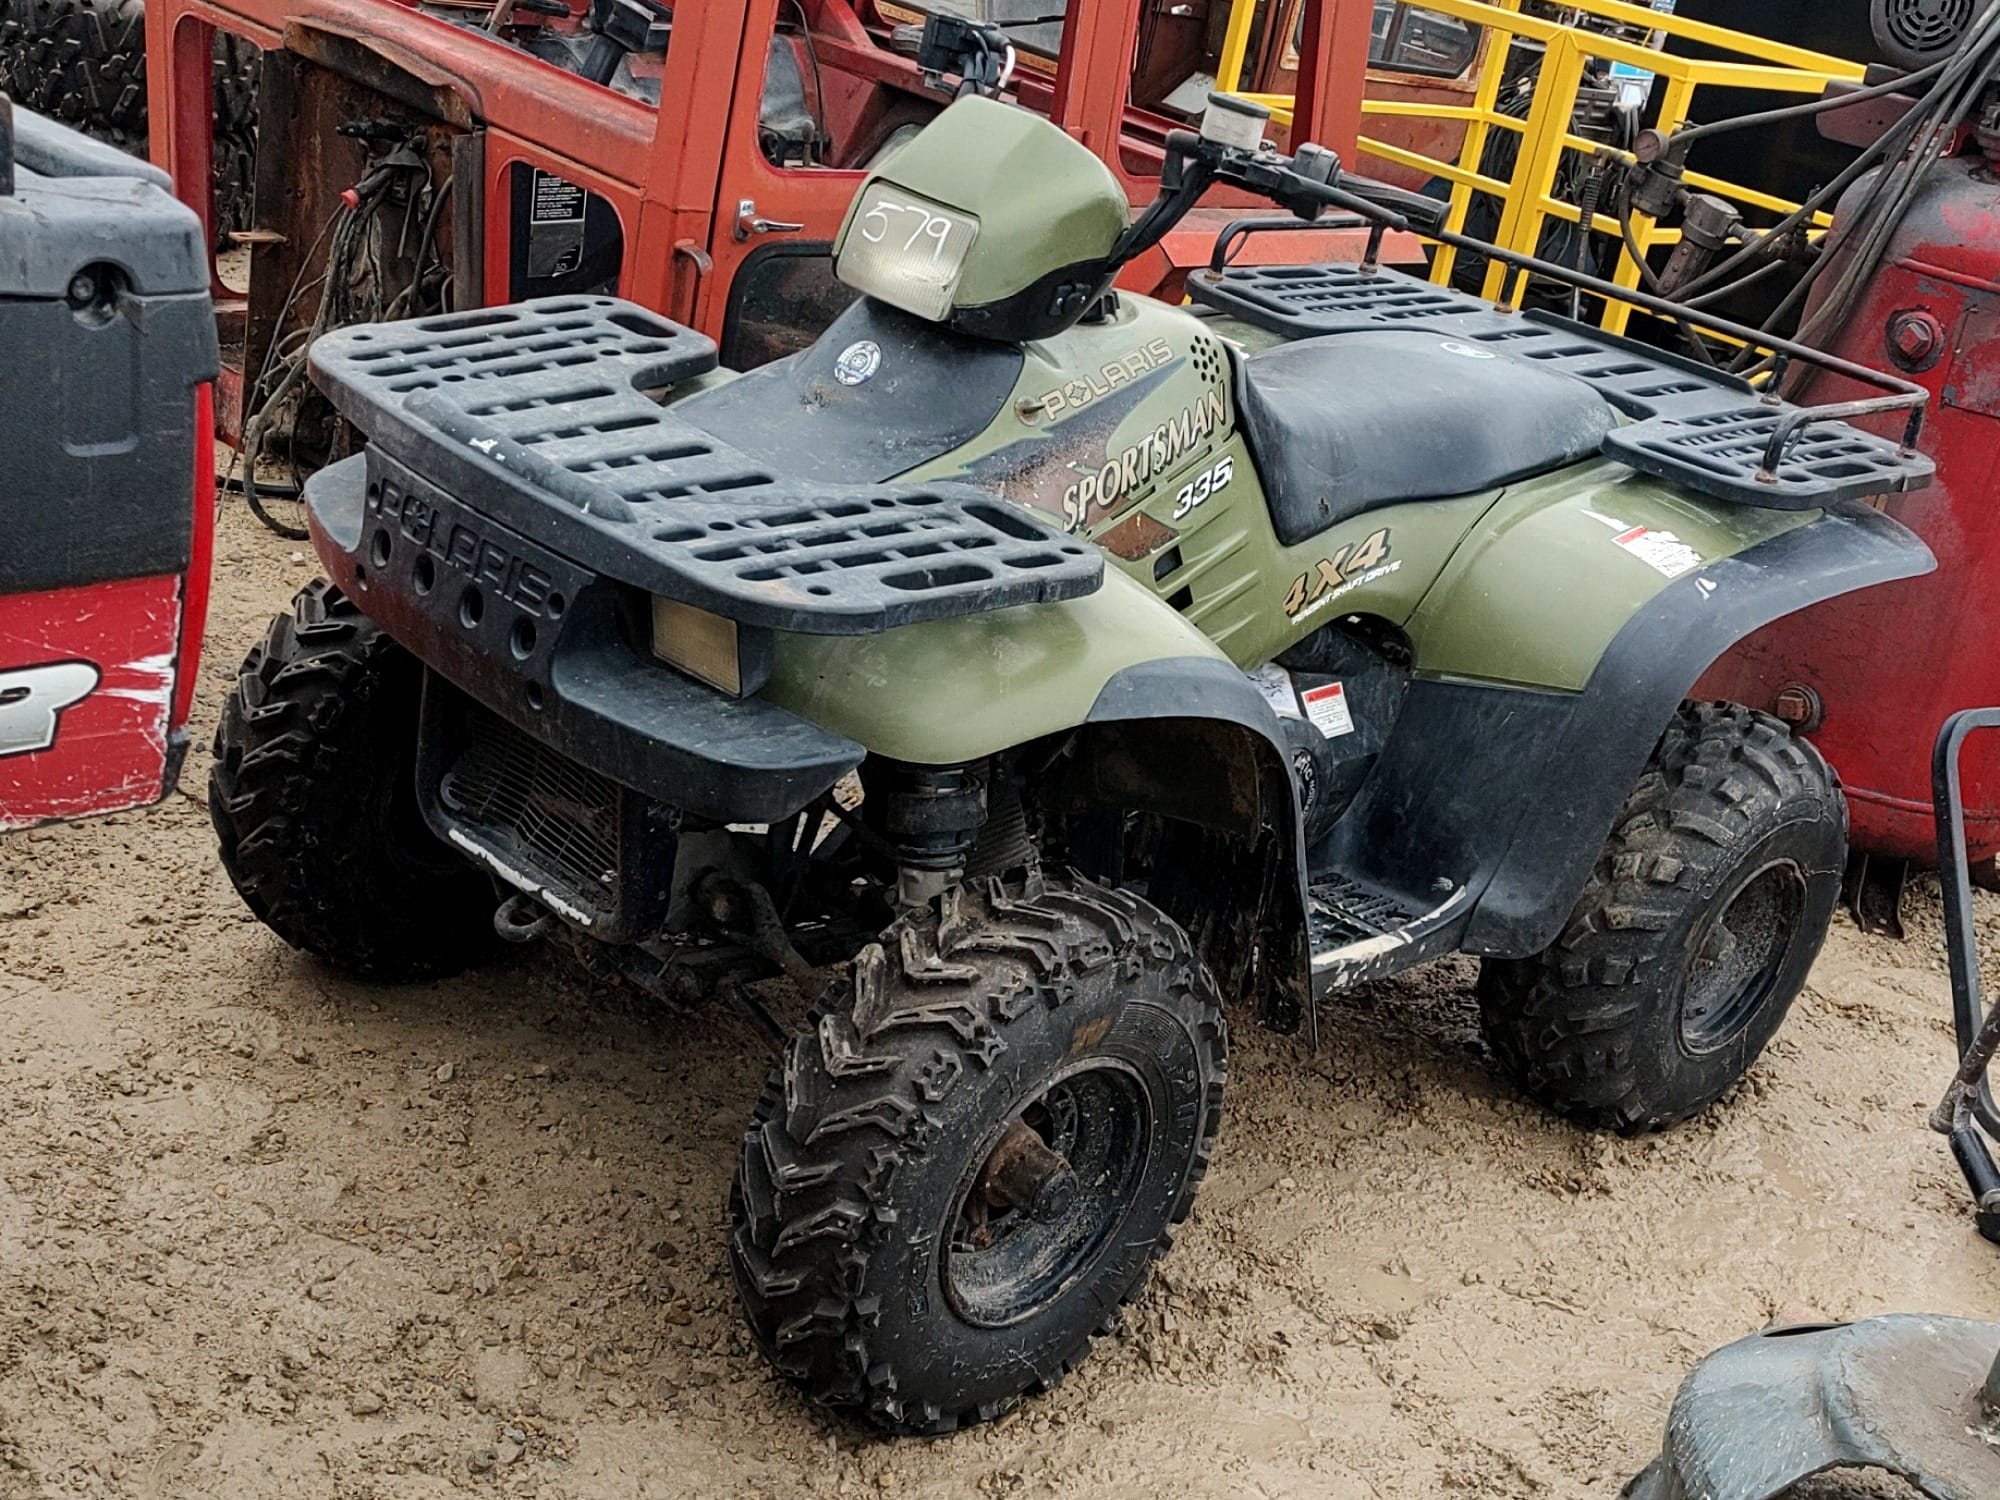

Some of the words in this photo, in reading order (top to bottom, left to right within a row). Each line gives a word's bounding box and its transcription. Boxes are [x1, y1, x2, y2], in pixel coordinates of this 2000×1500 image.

[862, 201, 952, 262] 579
[1039, 337, 1175, 421] POLARIS
[1062, 379, 1226, 534] SPORTSMAN
[1172, 454, 1234, 520] 335
[376, 478, 552, 617] POLARIS
[1363, 558, 1403, 584] DRIVE
